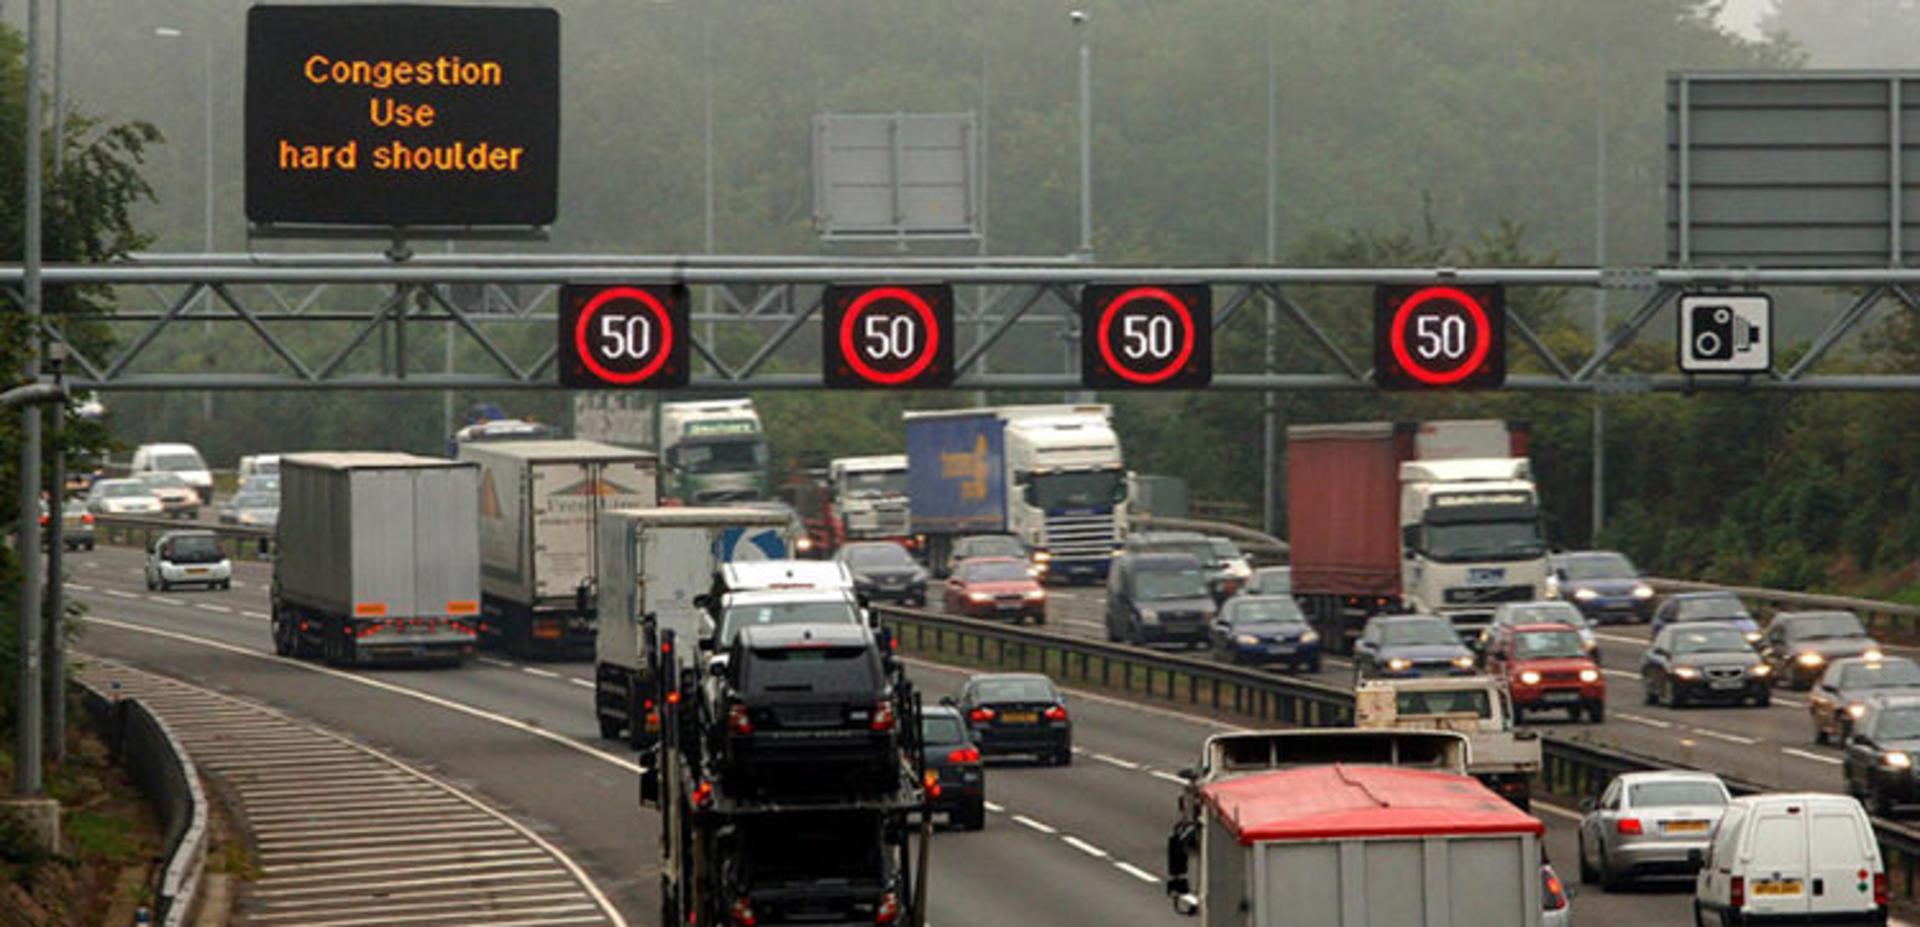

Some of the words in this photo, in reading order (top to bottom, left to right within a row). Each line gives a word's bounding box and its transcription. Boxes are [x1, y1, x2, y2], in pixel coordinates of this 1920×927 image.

[305, 55, 501, 88] Congestion
[370, 98, 436, 127] Use
[279, 140, 357, 170] hard
[373, 140, 523, 171] shoulder
[601, 314, 650, 359] 50
[865, 315, 915, 359] 50
[1123, 314, 1173, 359] 50
[1417, 315, 1466, 359] 50
